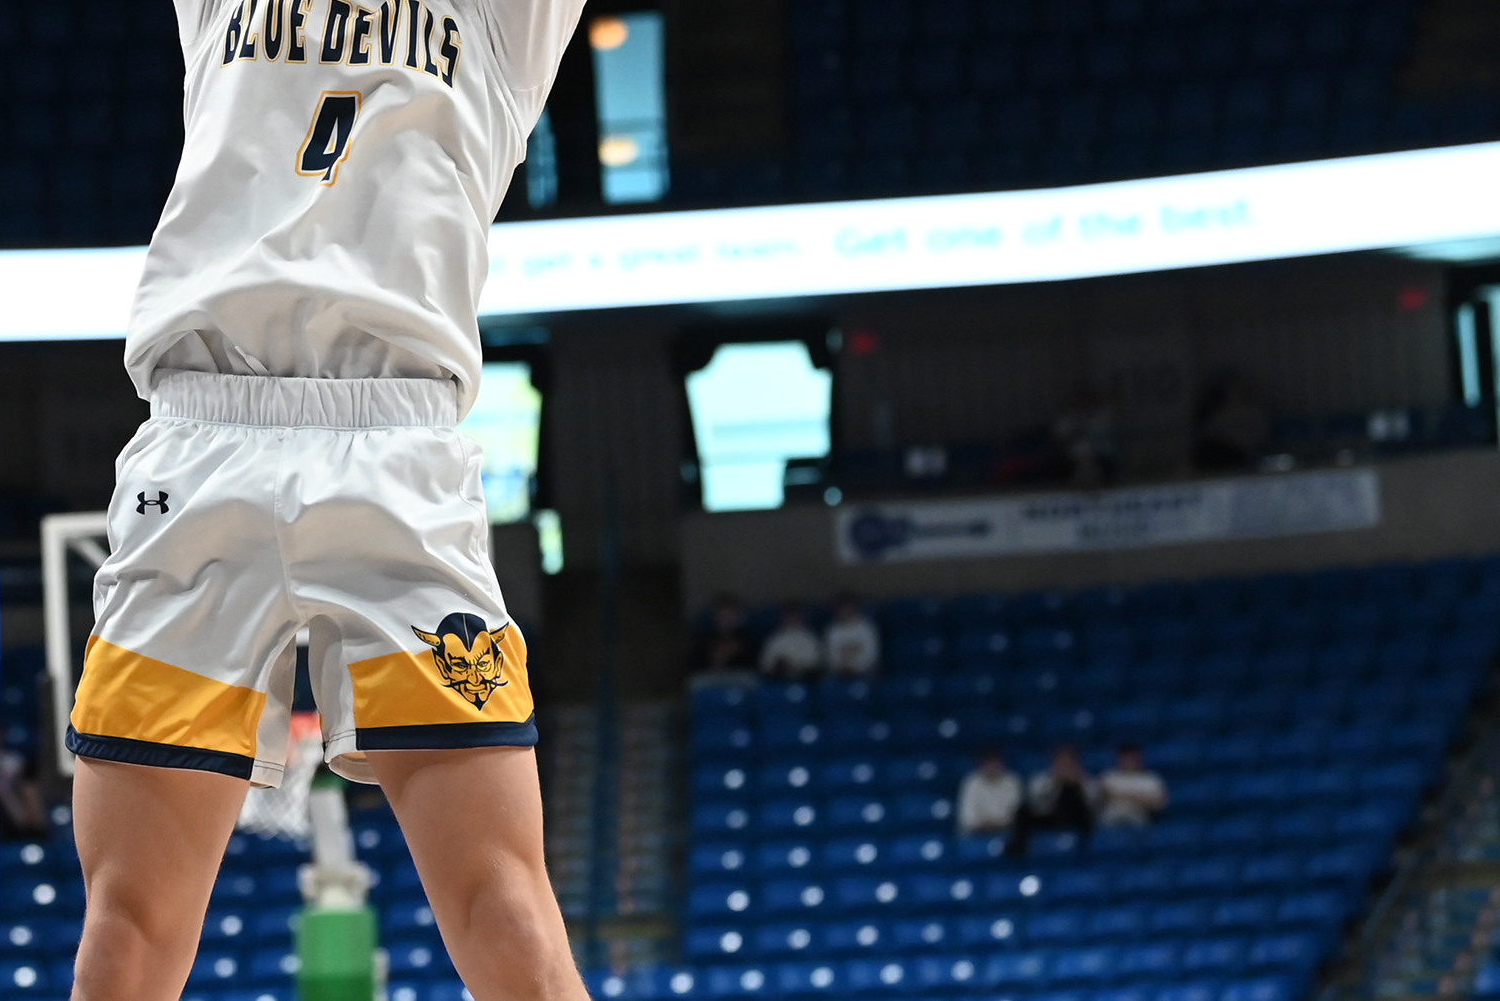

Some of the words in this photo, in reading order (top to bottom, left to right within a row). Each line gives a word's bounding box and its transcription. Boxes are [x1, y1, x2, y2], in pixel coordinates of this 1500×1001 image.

[295, 90, 362, 187] 4
[833, 223, 907, 259] Get
[925, 225, 1004, 255] one
[1021, 214, 1064, 248] of
[1077, 208, 1144, 241] the
